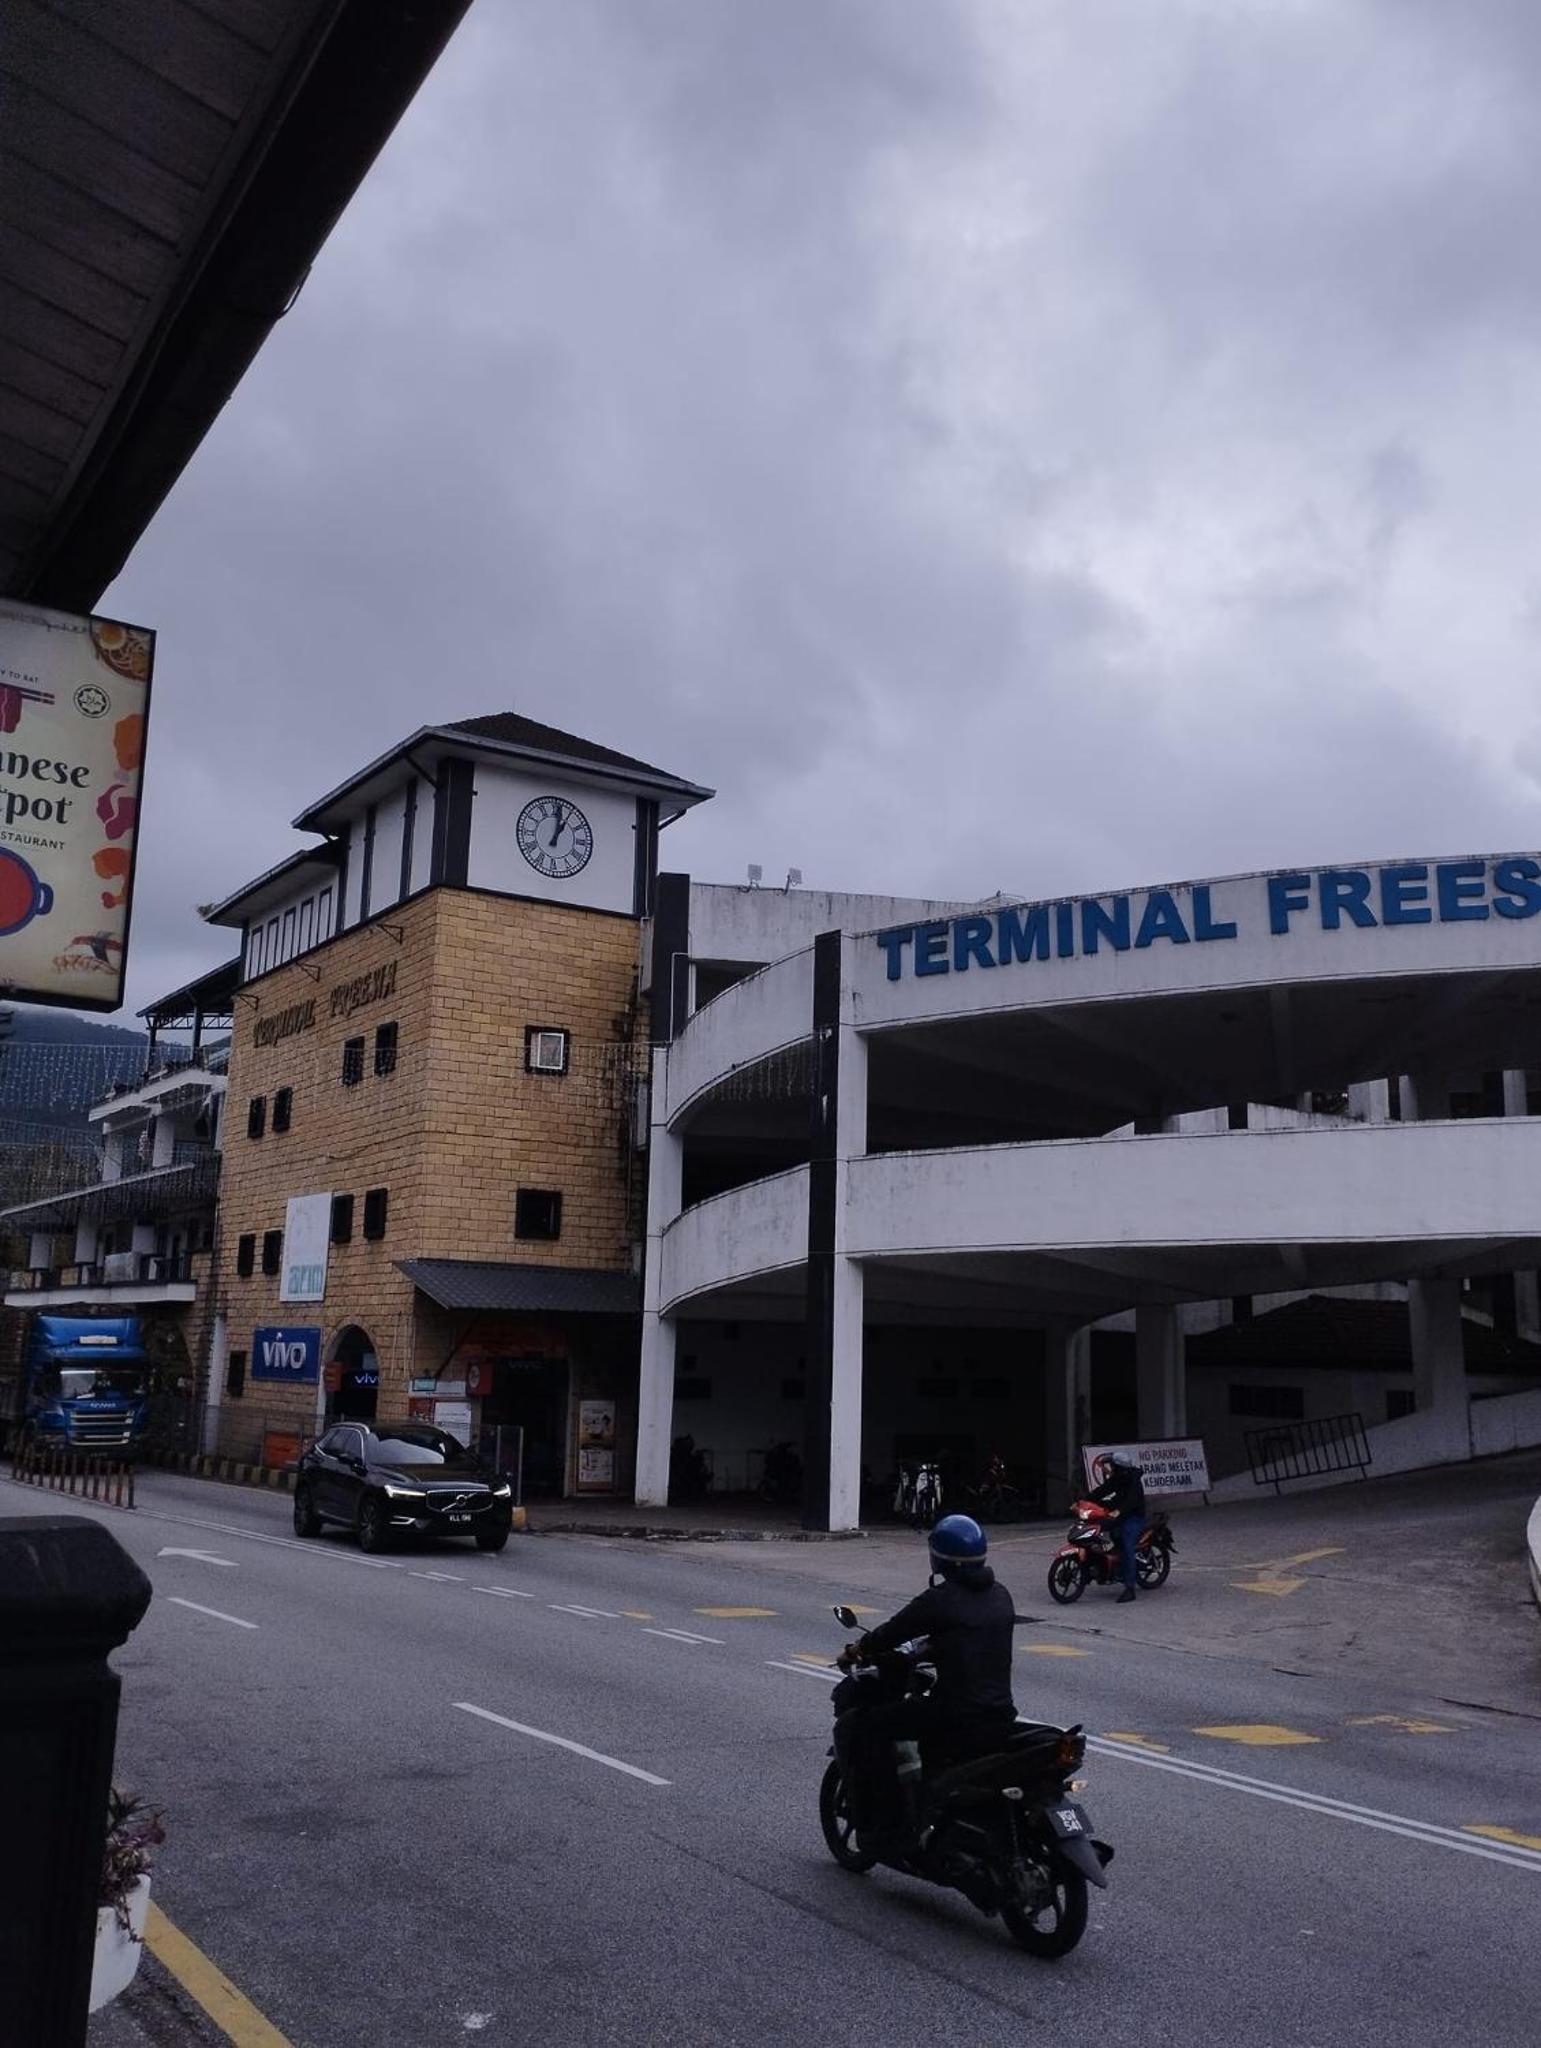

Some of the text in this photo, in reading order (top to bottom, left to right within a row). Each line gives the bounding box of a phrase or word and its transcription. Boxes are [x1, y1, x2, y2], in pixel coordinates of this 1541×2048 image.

[877, 859, 1541, 981] TERMINAL FREES
[262, 1332, 307, 1370] vivo
[1138, 1448, 1187, 1461] NO PARKING
[1168, 1460, 1205, 1473] MELETAK
[1144, 1475, 1193, 1488] KENDERAAN
